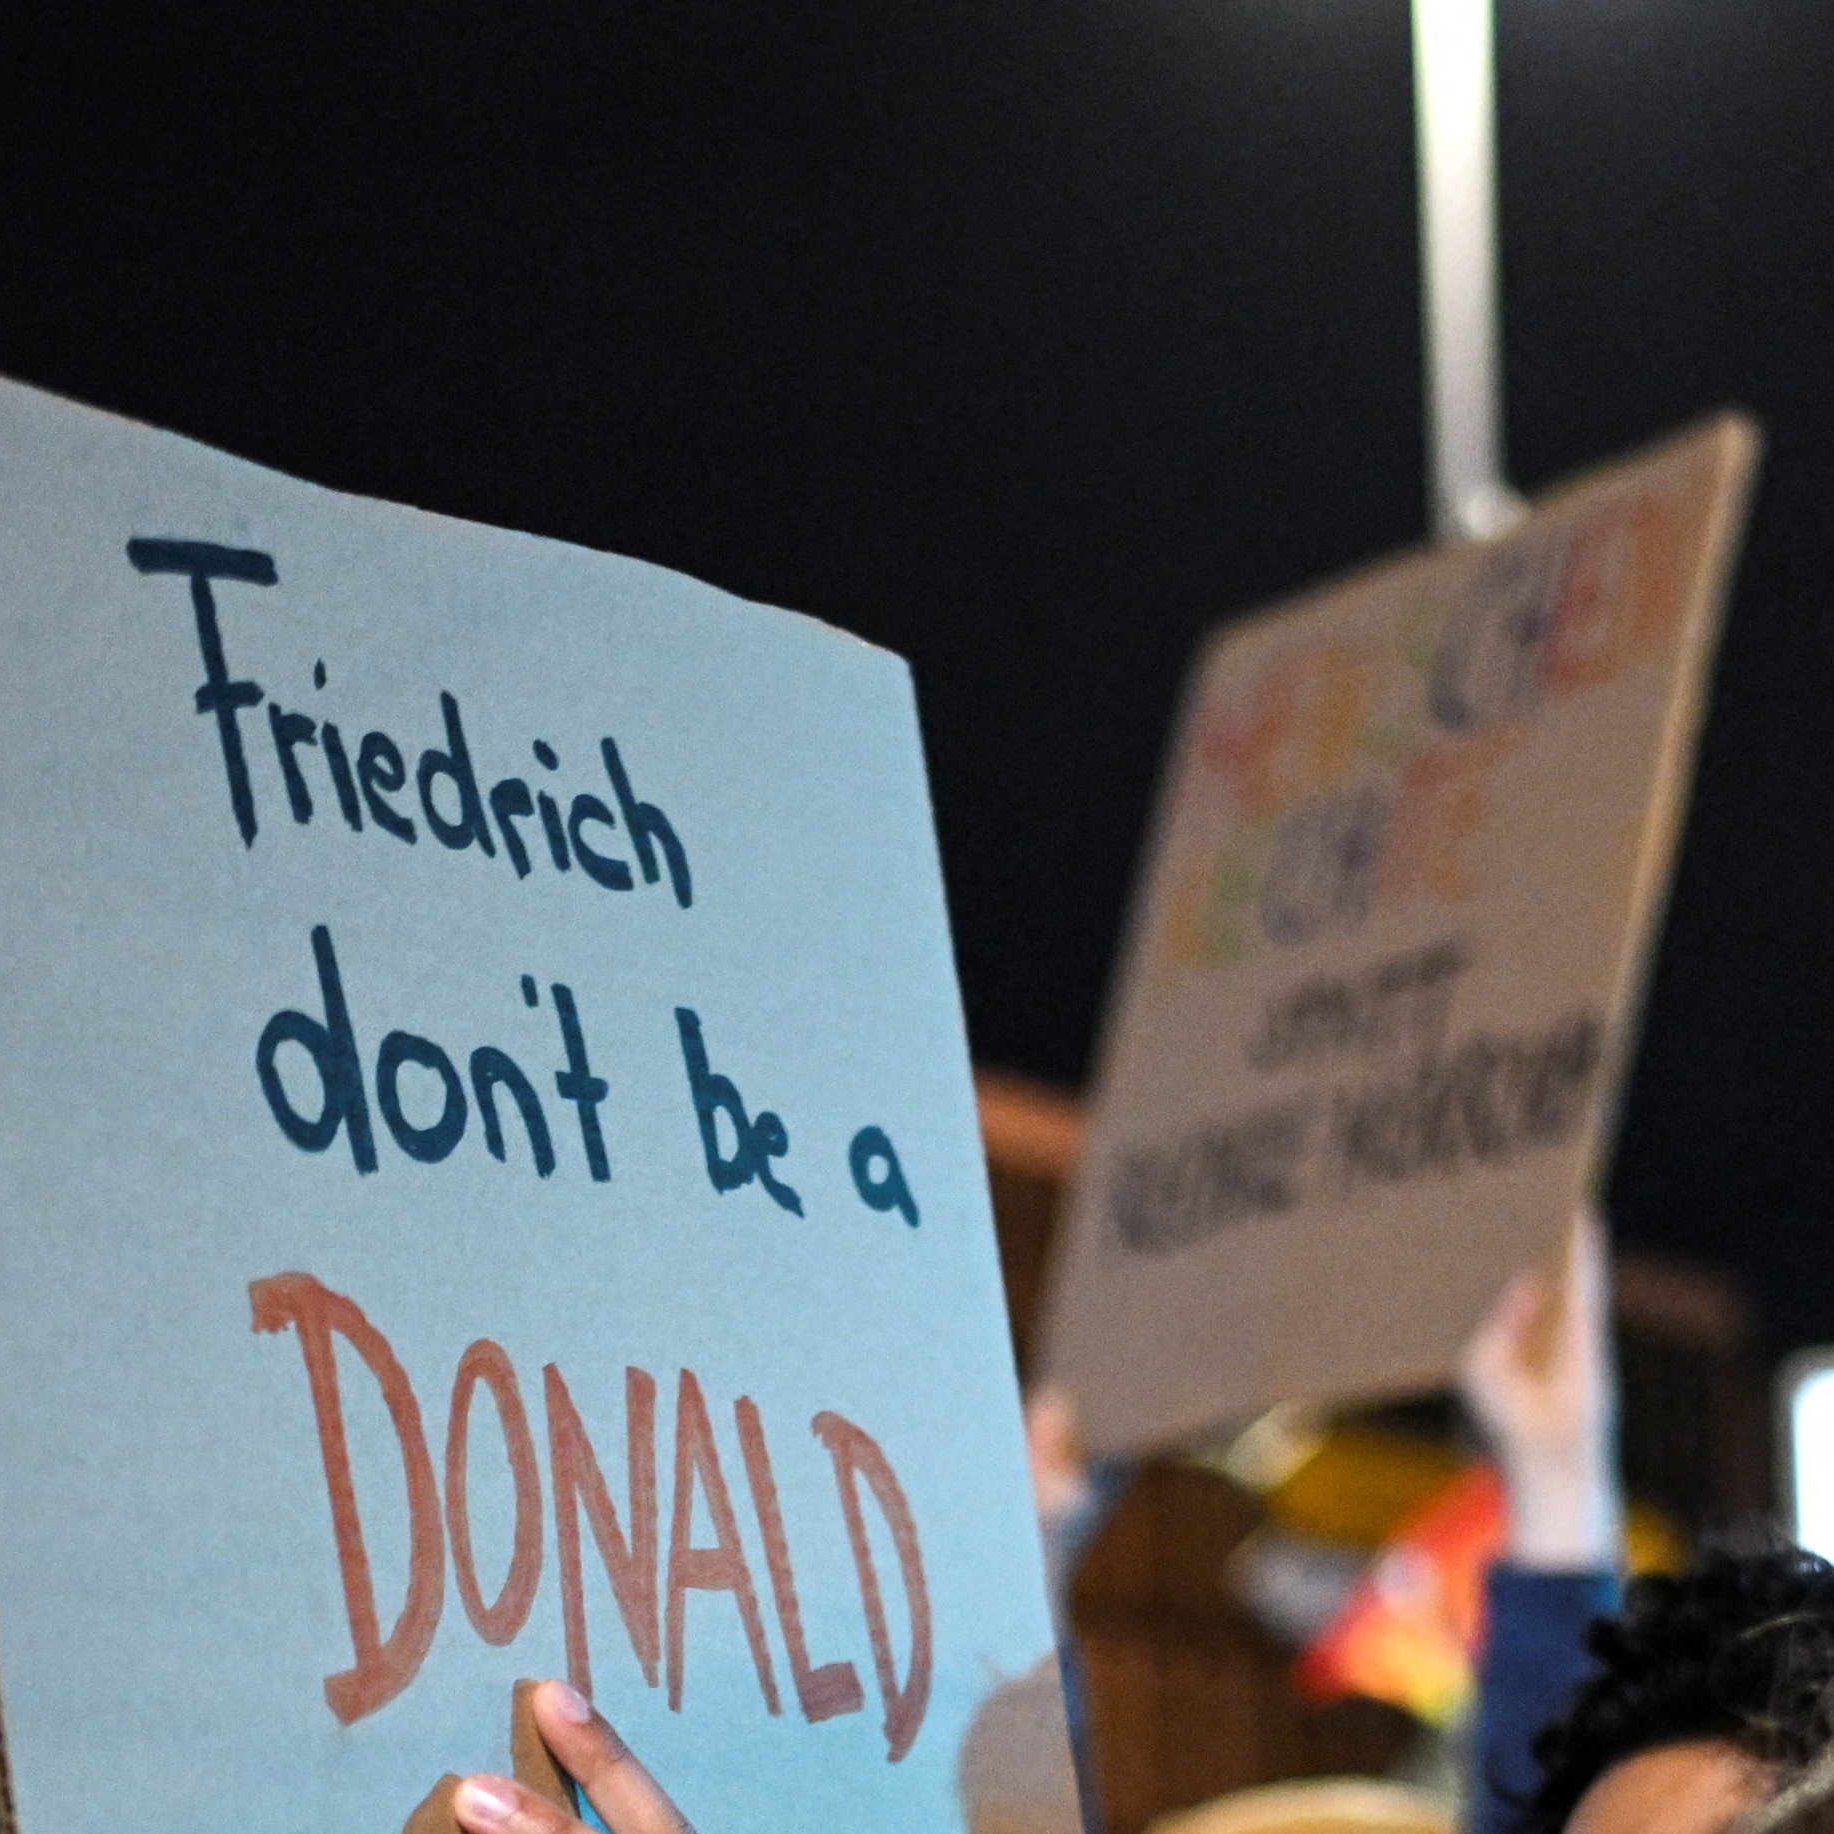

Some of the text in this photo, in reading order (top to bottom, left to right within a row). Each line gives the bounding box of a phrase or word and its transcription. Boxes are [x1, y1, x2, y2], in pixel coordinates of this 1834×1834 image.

[126, 537, 693, 909] Friedrich
[255, 923, 611, 1184] don't
[674, 1006, 805, 1218] be
[848, 1125, 921, 1229] a
[247, 1271, 933, 1764] DONALD
